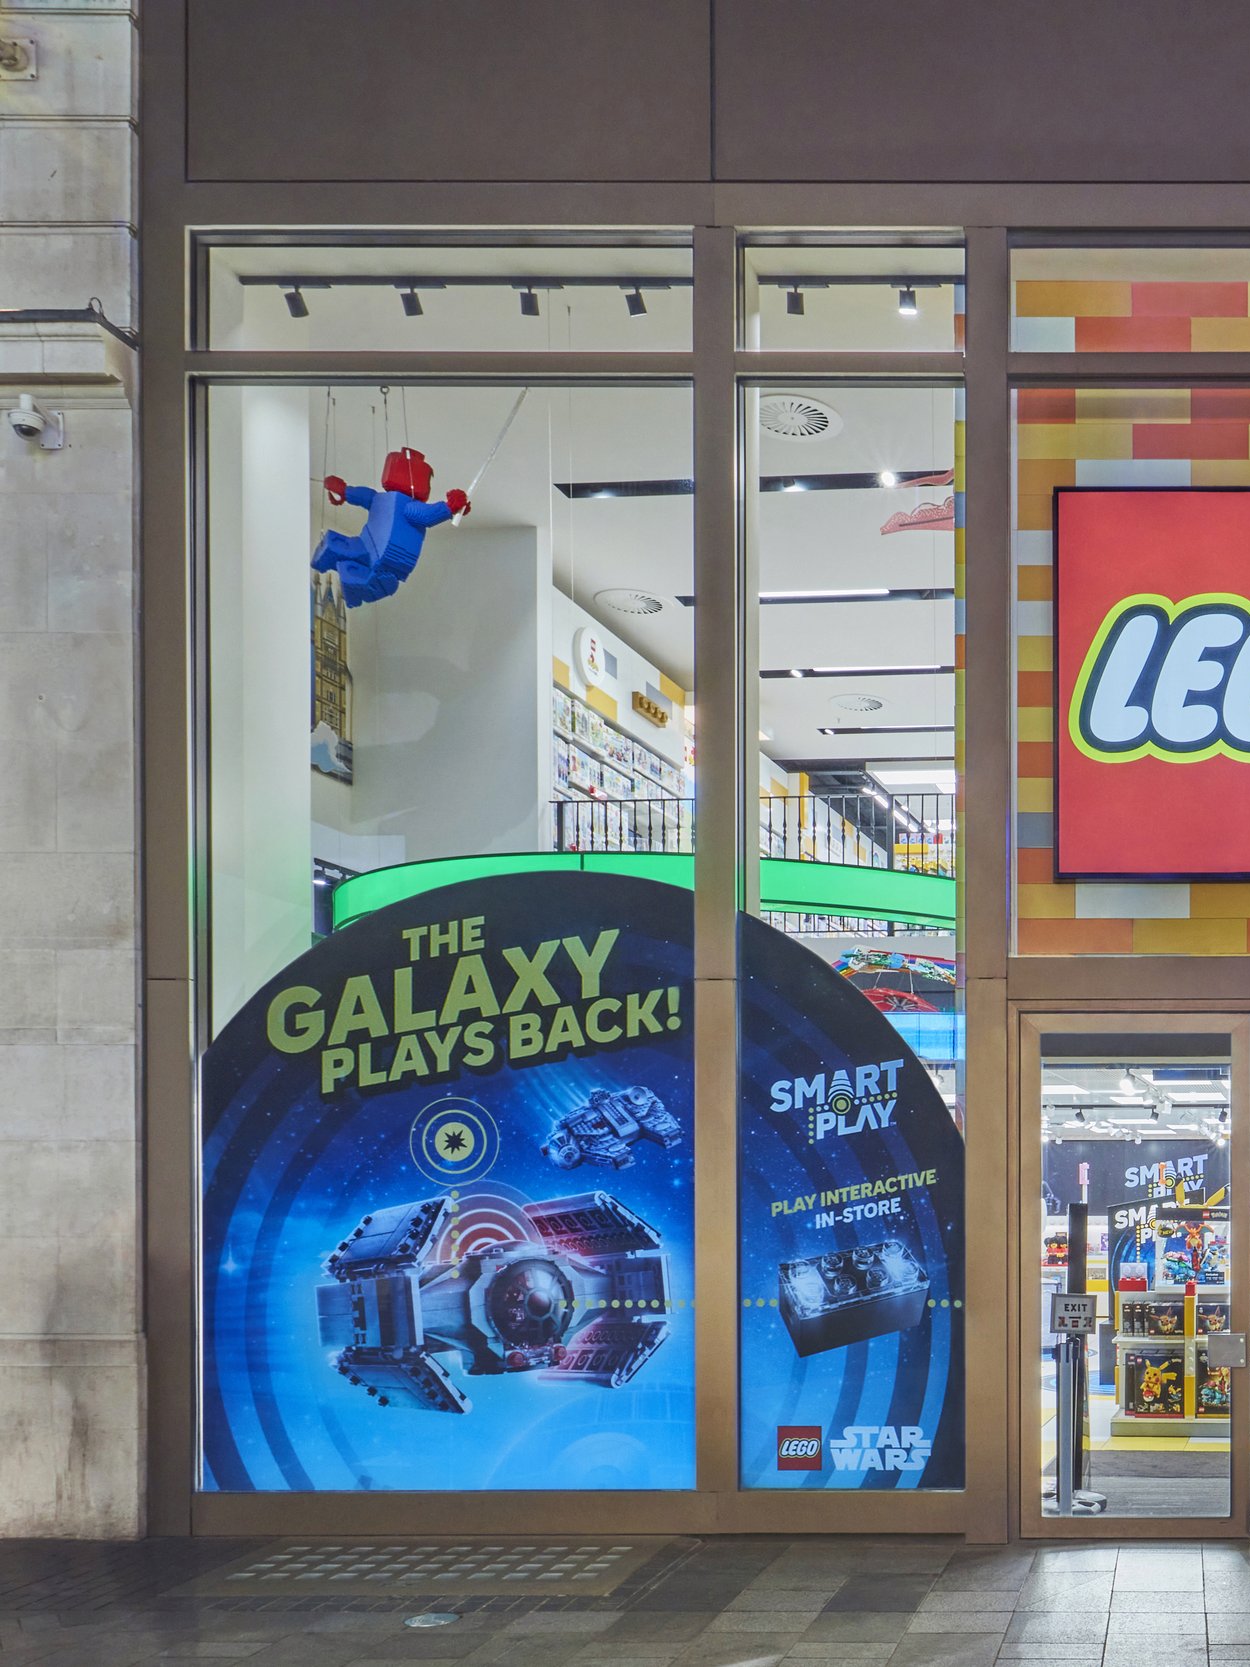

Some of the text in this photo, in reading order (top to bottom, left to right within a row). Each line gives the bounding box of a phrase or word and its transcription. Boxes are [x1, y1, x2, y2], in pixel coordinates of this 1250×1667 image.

[402, 915, 486, 961] THE
[266, 928, 620, 1054] GALAXY
[320, 986, 682, 1094] PLAYS BACK!
[769, 1058, 904, 1113] SMART
[816, 1099, 897, 1140] PLAY
[771, 1168, 937, 1217] PLAY INTERACTIVE
[815, 1197, 901, 1229] IN-STORE
[1064, 1303, 1088, 1312] EXIT
[780, 1438, 820, 1458] LEGO
[830, 1425, 932, 1448] STAR
[830, 1448, 932, 1471] WARS
